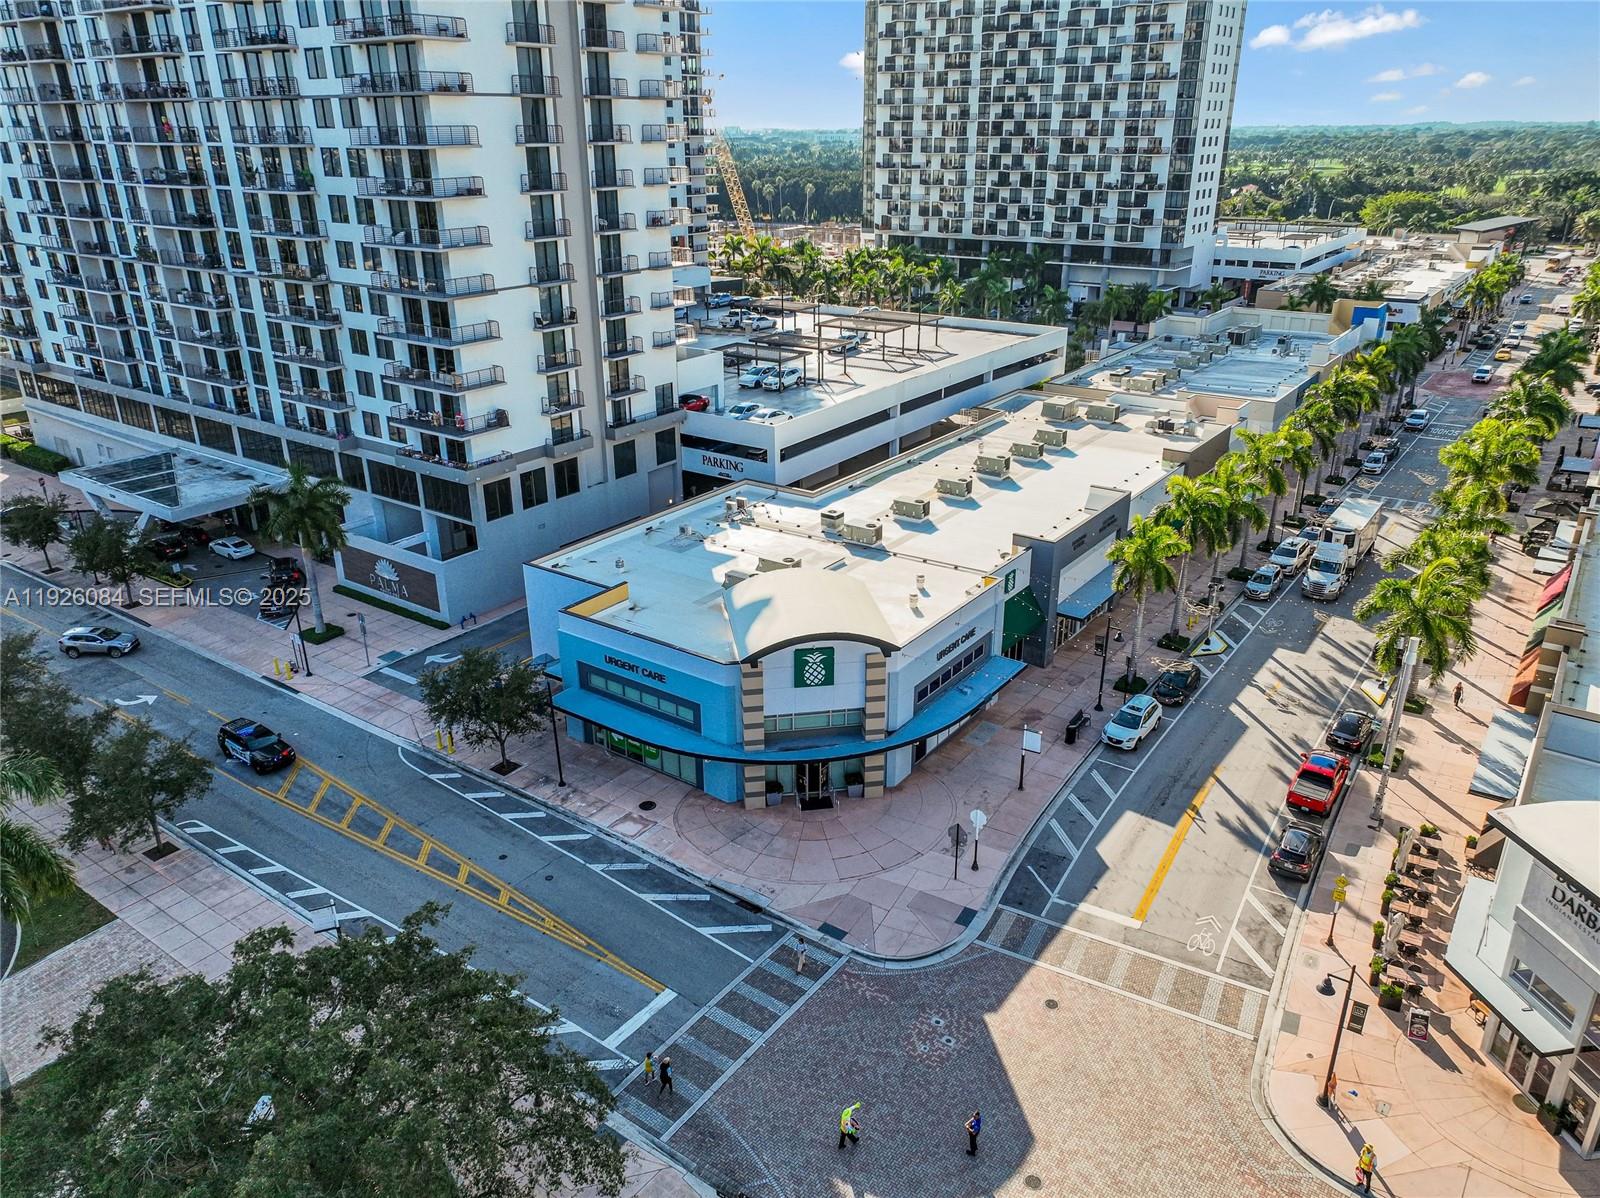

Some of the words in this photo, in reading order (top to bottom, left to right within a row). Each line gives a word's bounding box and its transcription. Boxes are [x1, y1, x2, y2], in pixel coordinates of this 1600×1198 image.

[702, 455, 744, 472] PARKING
[369, 573, 409, 598] PALMA
[936, 637, 961, 661] URGENT
[604, 654, 640, 673] URGENT
[641, 667, 666, 683] CARE
[1545, 897, 1572, 921] INDIAN
[1551, 885, 1600, 933] DARB
